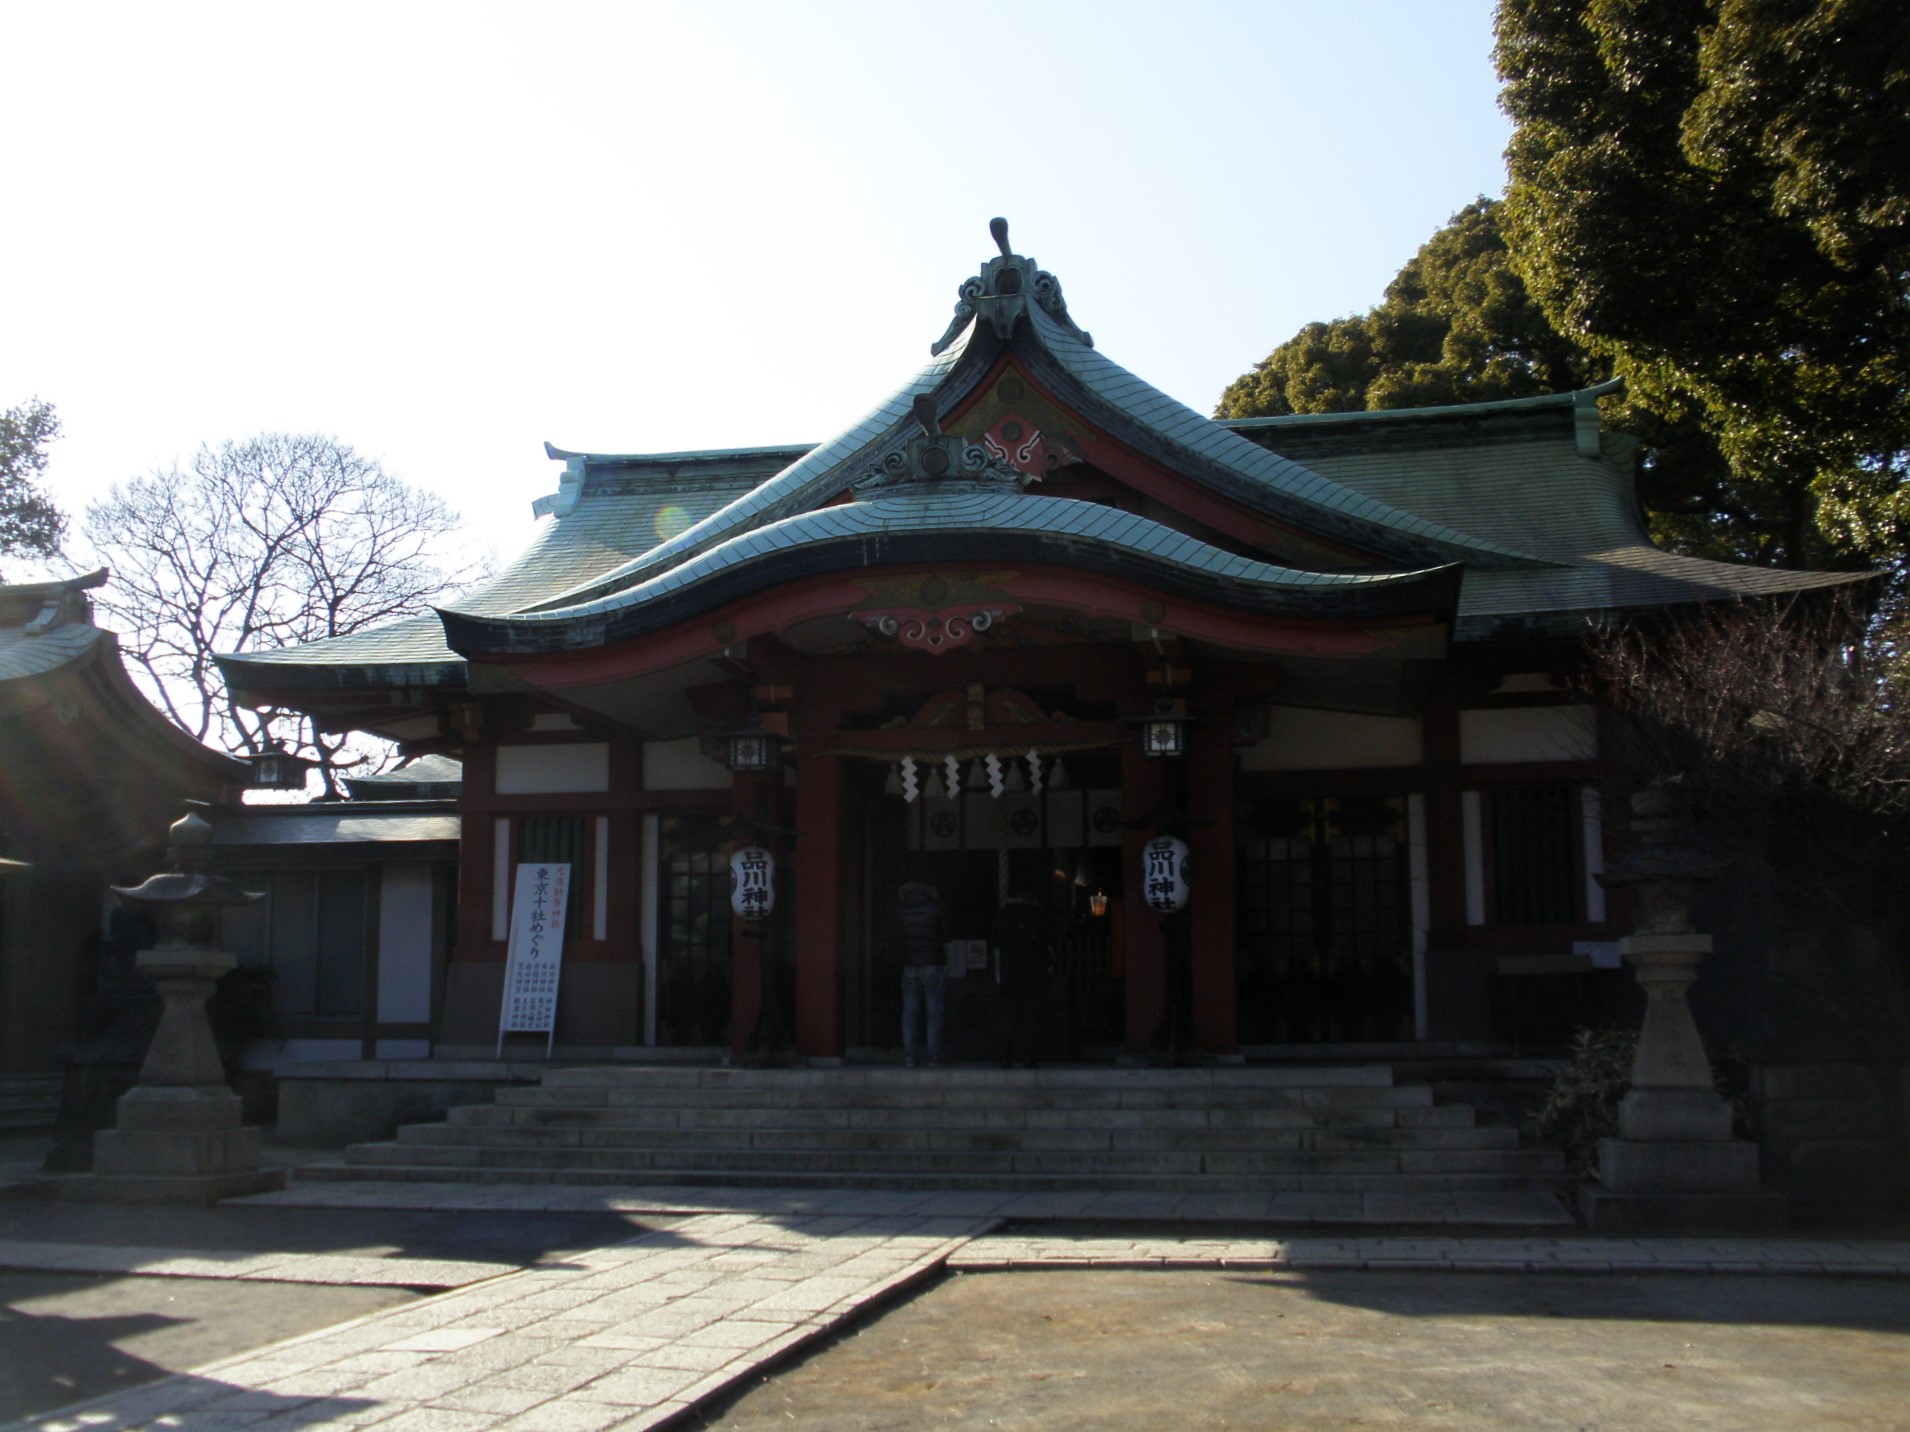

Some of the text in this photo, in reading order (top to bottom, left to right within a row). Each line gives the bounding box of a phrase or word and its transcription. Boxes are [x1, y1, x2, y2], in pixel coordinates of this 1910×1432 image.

[741, 850, 768, 917] 品川神社
[1148, 841, 1175, 909] 品川神社
[530, 867, 549, 959] 東京十社めぐり
